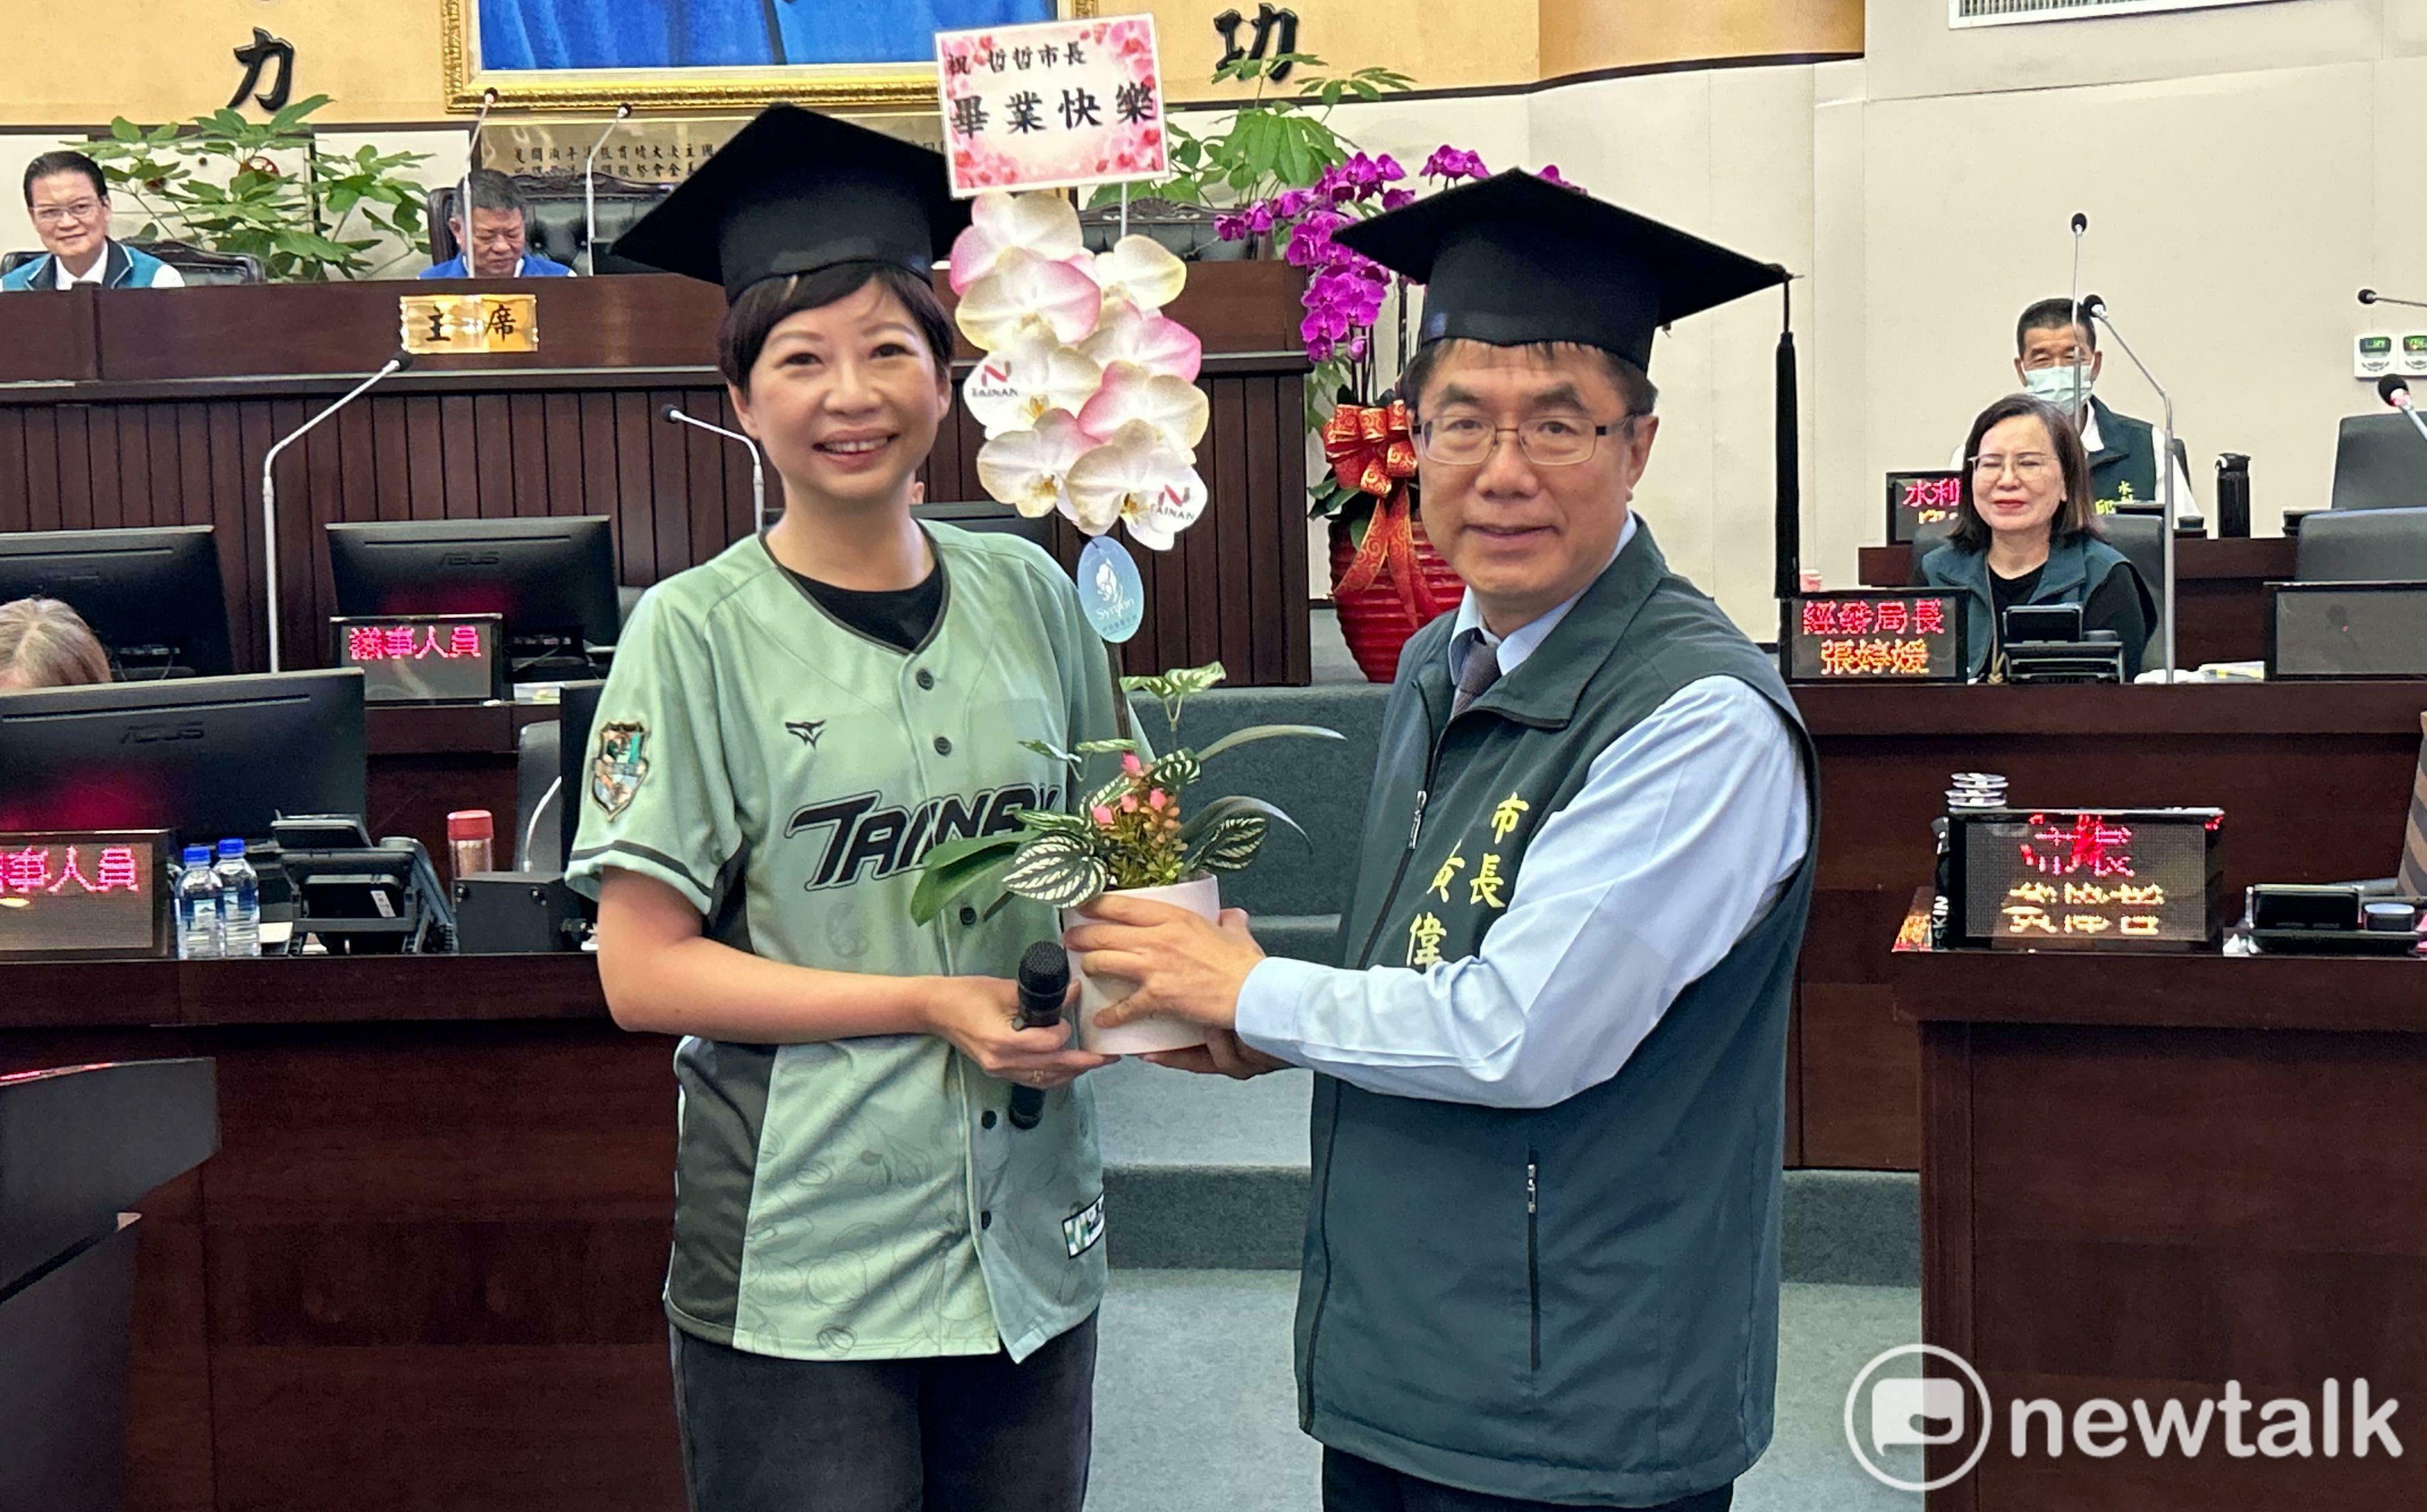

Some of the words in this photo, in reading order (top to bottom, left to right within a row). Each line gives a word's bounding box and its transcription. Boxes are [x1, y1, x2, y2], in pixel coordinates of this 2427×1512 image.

[1213, 3, 1299, 82] 功
[227, 26, 294, 111] 力
[947, 53, 971, 76] 祝
[950, 81, 1157, 139] 畢業快樂
[425, 304, 517, 342] 主席
[972, 387, 1018, 398] TAINAN
[1902, 477, 1961, 507] 水利
[1150, 506, 1195, 521] TAINAN
[438, 551, 501, 566] ASUS
[1802, 598, 1945, 636] 經發局長
[119, 720, 205, 744] ASUS
[1469, 791, 1530, 908] 市長
[0, 845, 141, 894] 事人員
